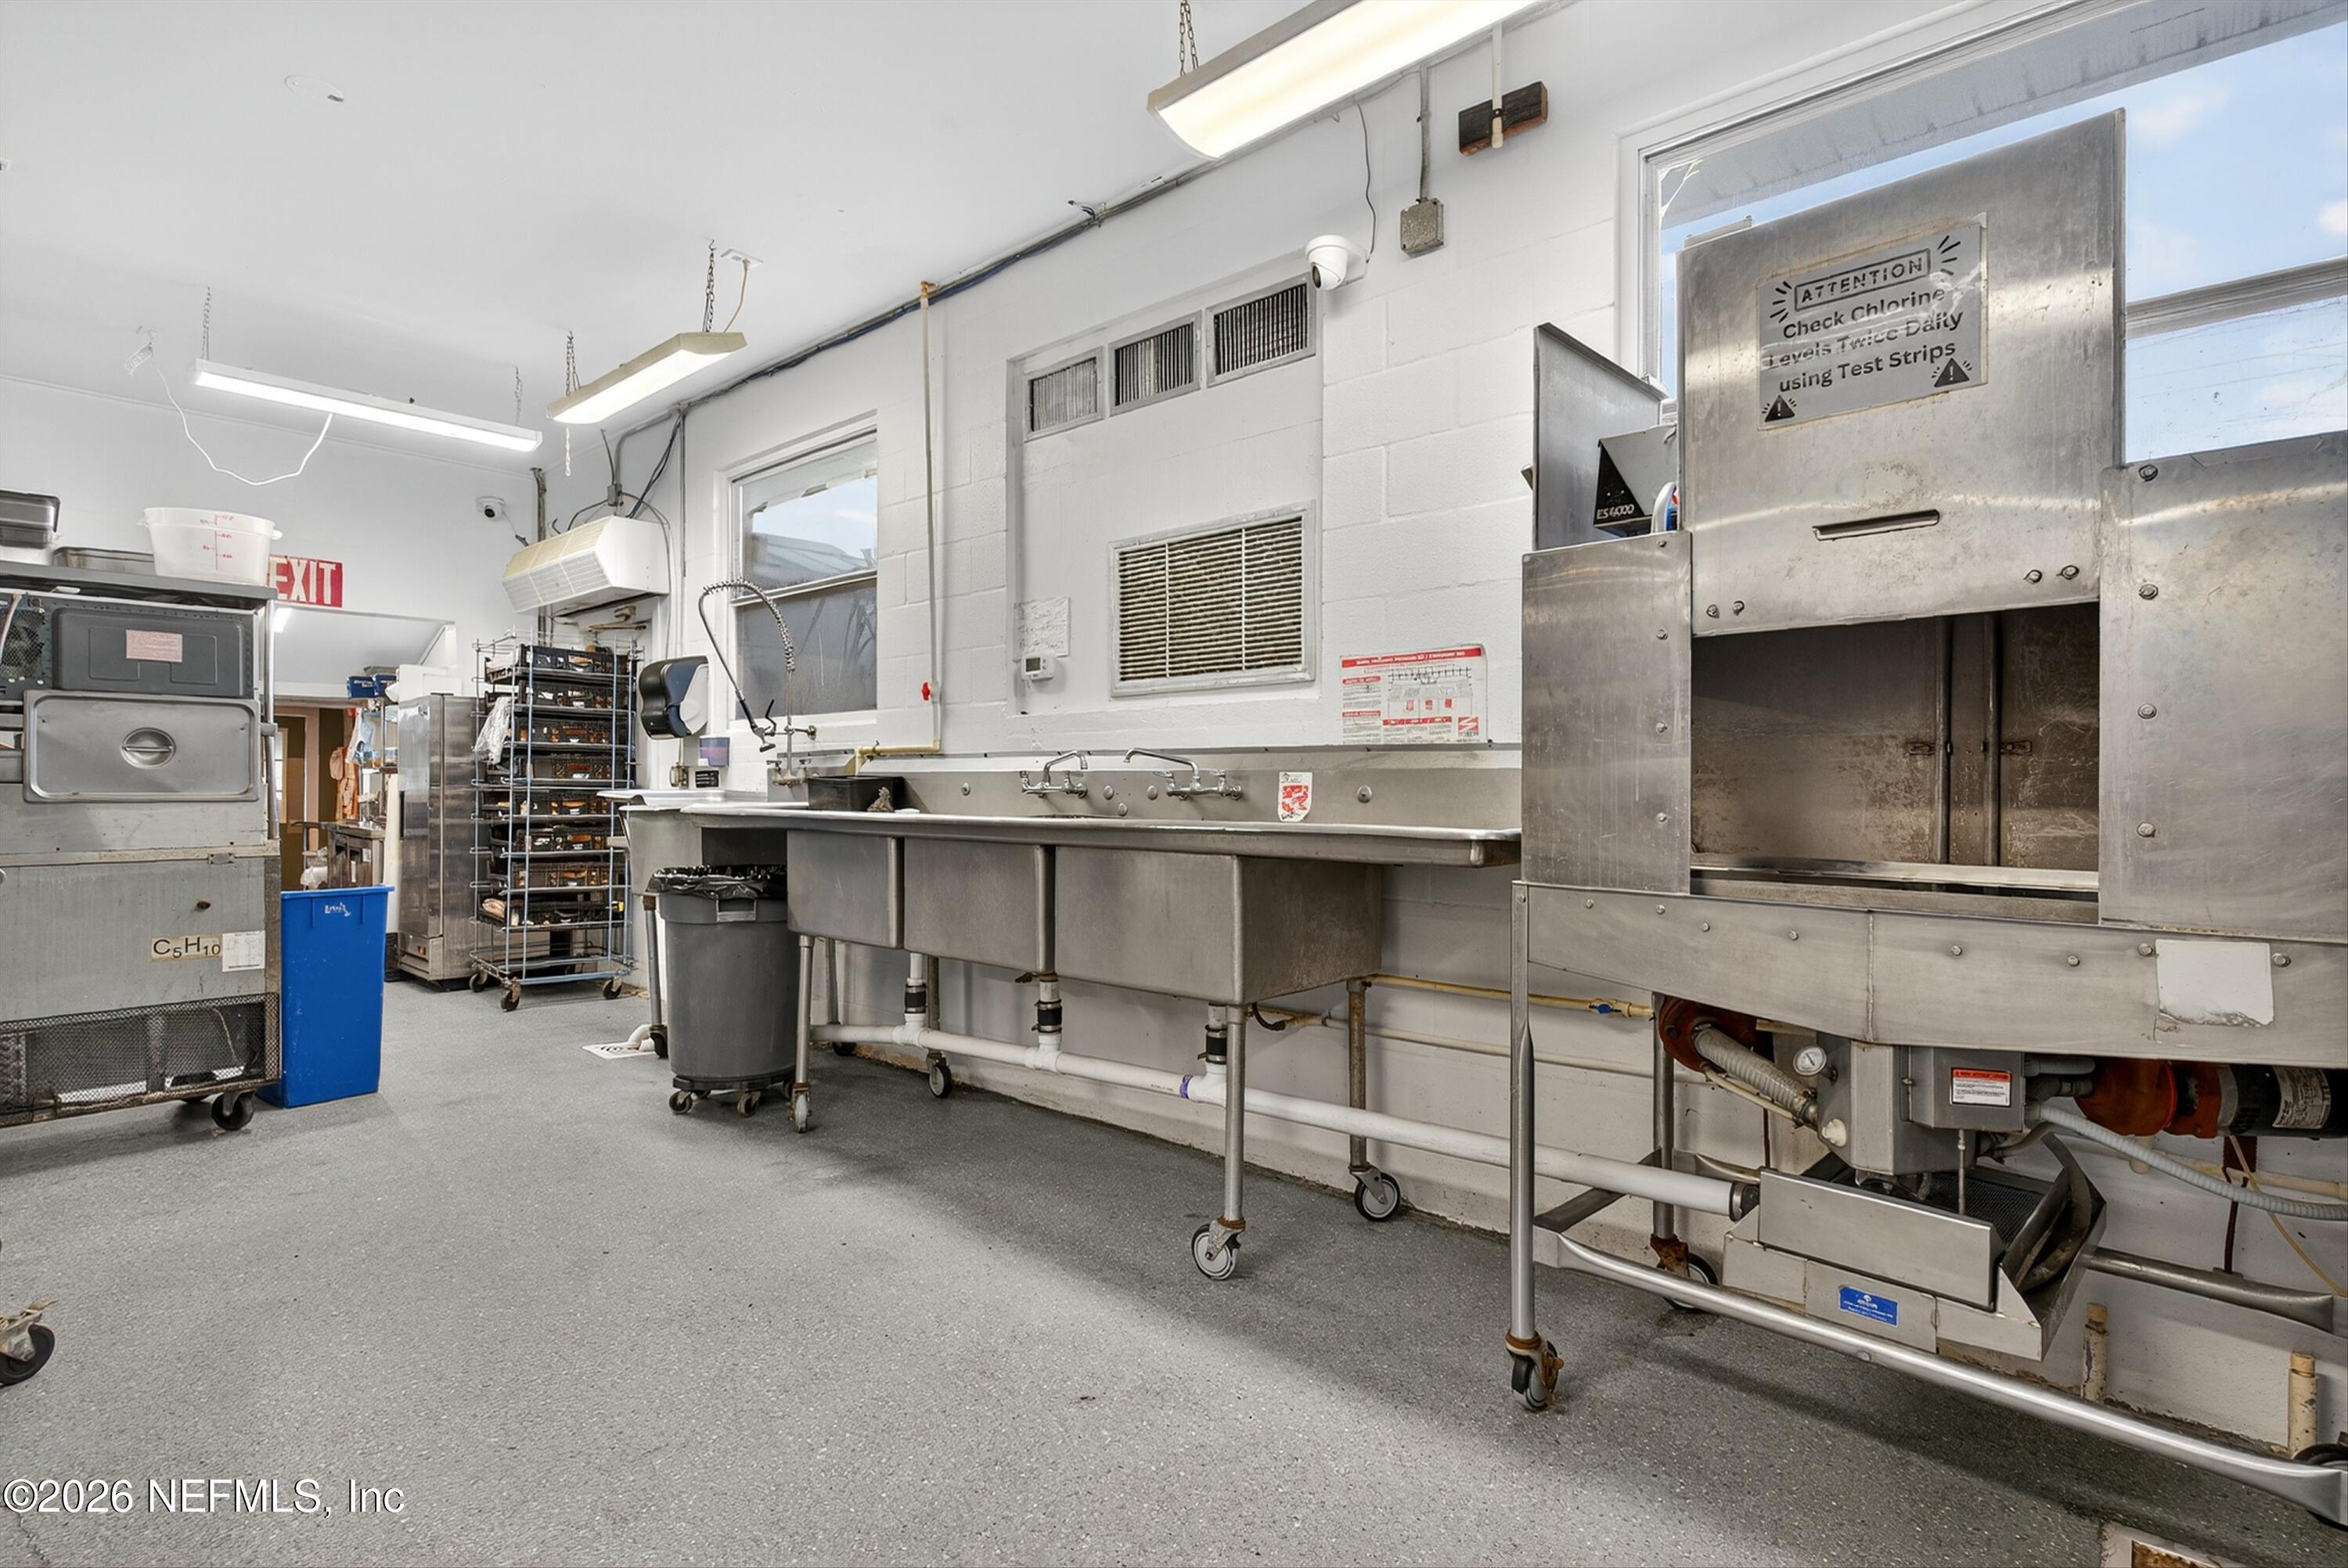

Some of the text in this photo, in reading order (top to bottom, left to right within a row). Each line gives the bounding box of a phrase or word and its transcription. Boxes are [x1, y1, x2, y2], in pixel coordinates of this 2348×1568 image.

[1802, 257, 1922, 303] ATTENTION
[1783, 288, 1946, 339] Check Chlorine
[1768, 343, 1831, 366] Levels
[1905, 312, 1964, 337] Daily
[1779, 342, 1956, 392] using Test Strips
[269, 557, 337, 605] EXIT
